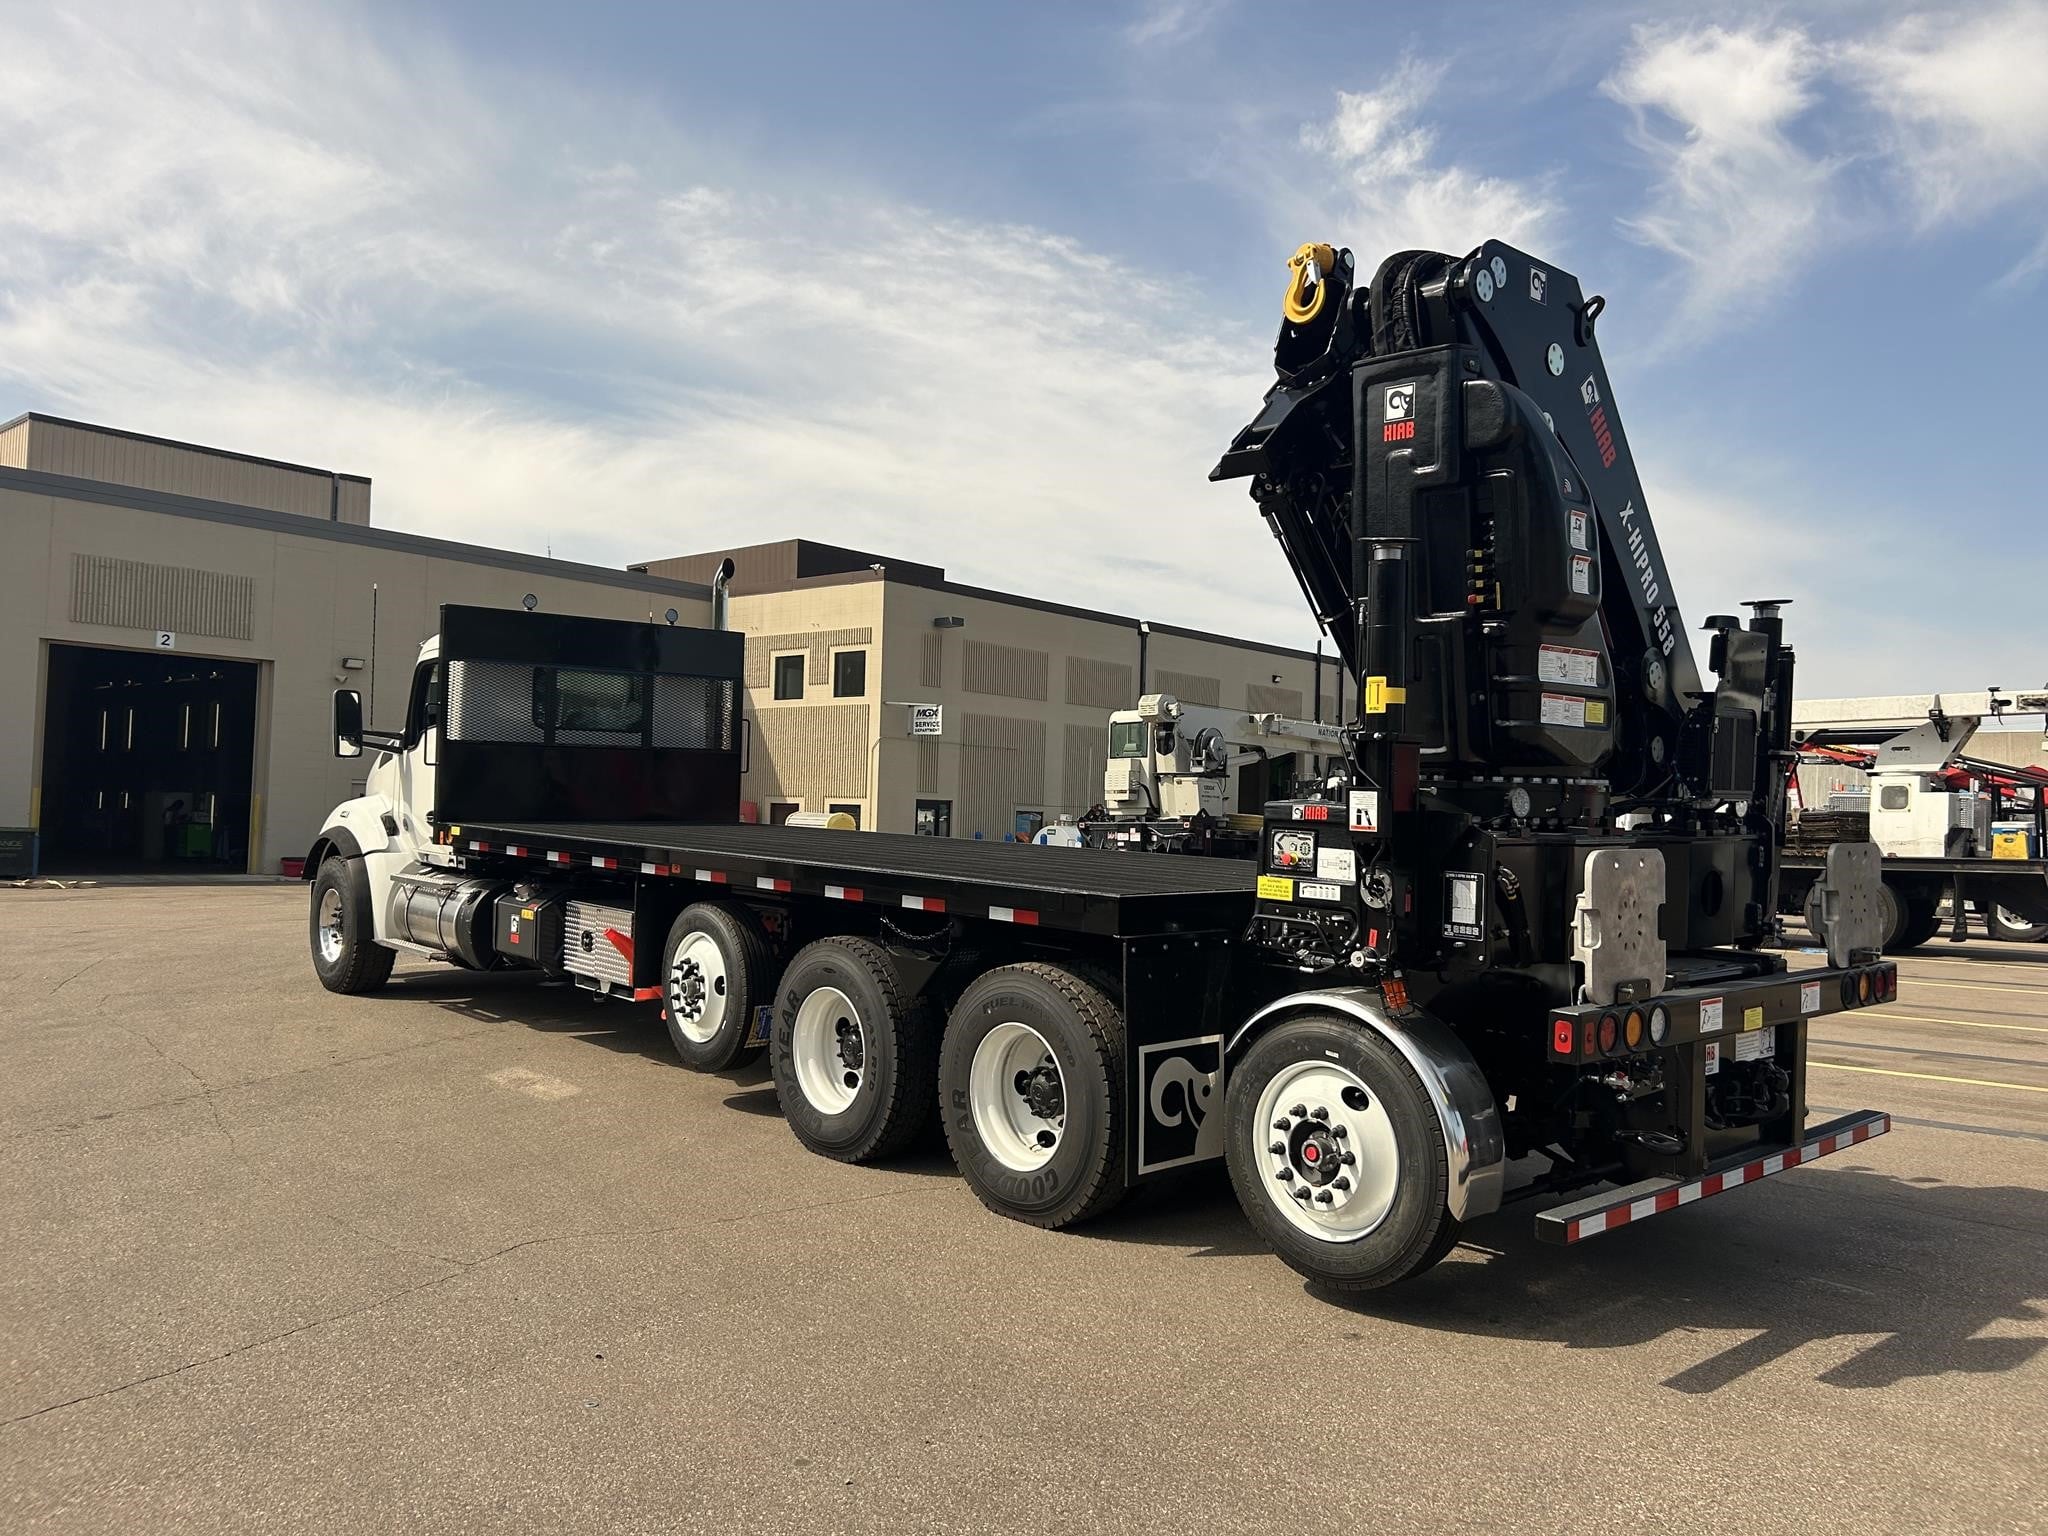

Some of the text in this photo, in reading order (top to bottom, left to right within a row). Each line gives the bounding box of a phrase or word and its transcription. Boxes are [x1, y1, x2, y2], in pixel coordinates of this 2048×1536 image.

[1383, 421, 1415, 442] HIAB
[1590, 407, 1617, 469] HIAB
[1619, 500, 1675, 657] X-HIPRO 558
[161, 634, 171, 646] 2
[1318, 727, 1338, 739] NATION
[1304, 805, 1328, 820] HIAB
[982, 996, 1019, 1015] FUEL
[1706, 1046, 1715, 1061] AB
[868, 1056, 878, 1091] RTD
[952, 1088, 1059, 1201] GOODYEAR
